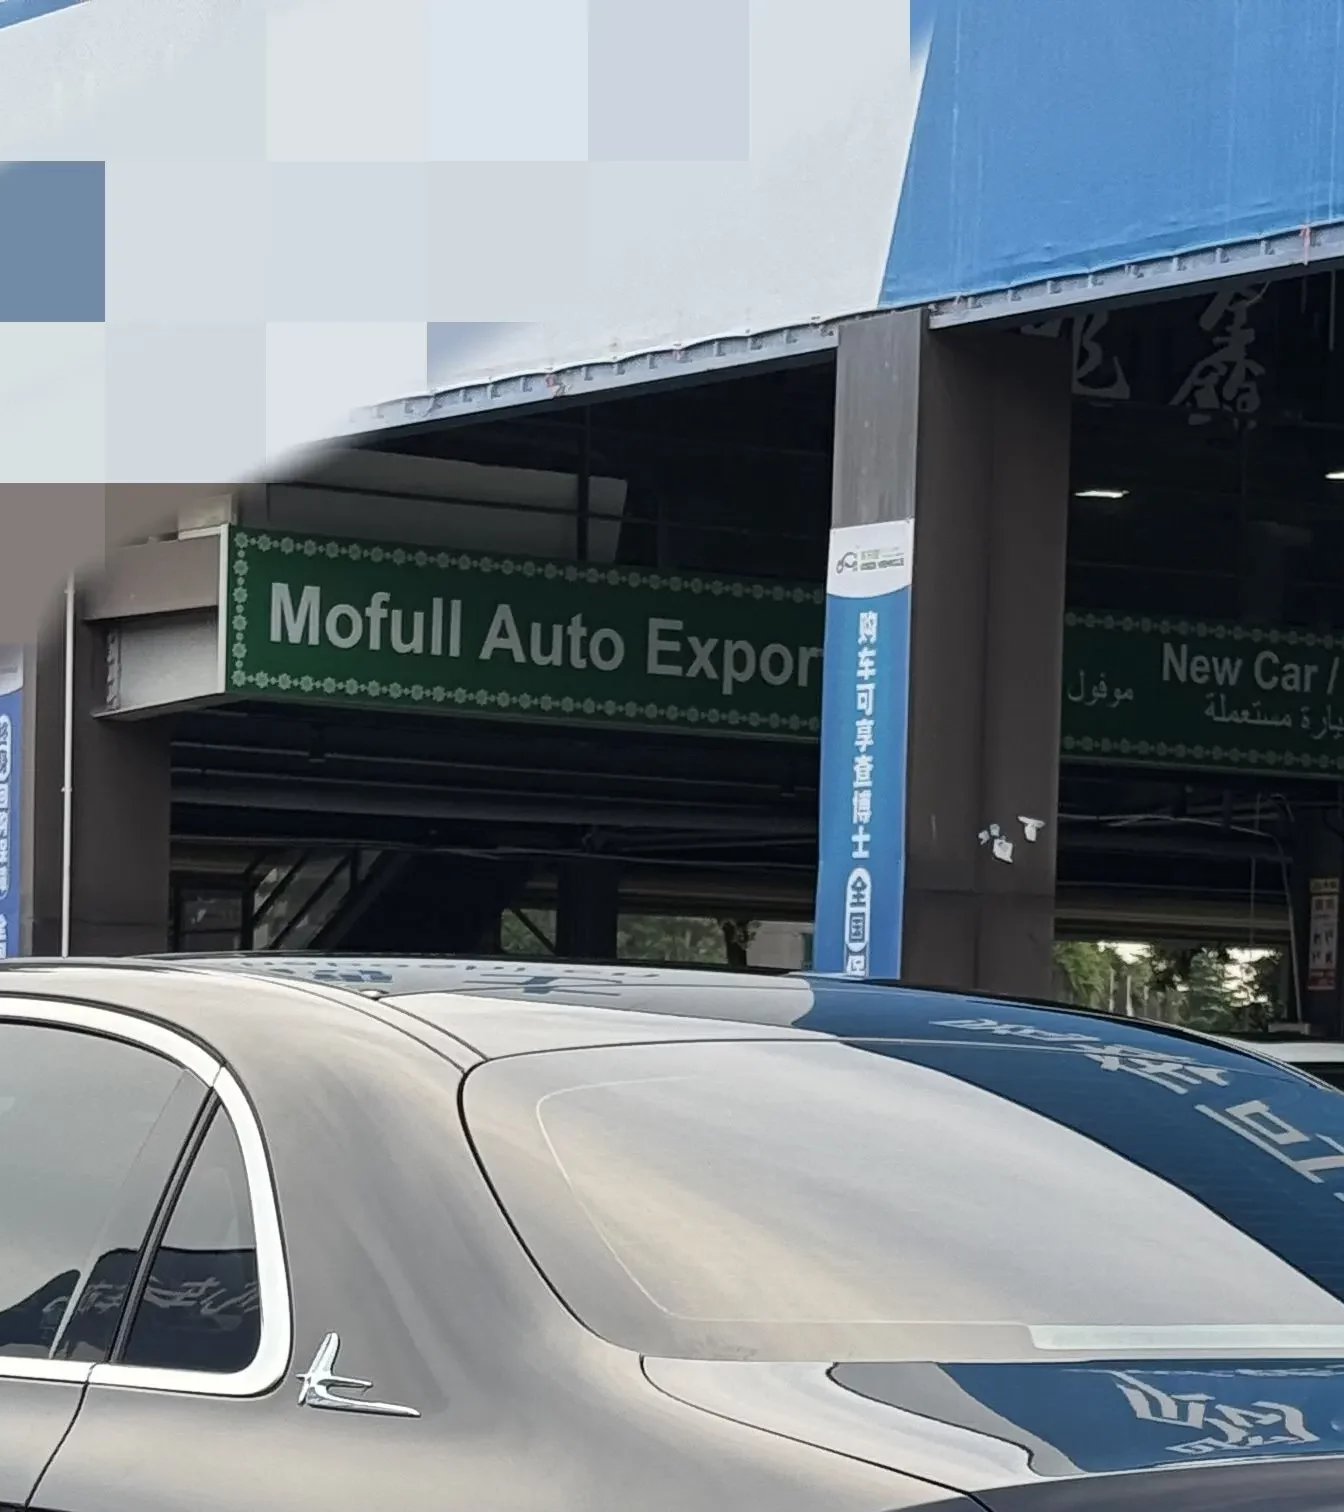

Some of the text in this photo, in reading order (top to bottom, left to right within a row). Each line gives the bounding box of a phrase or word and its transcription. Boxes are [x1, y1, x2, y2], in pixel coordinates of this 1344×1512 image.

[268, 582, 462, 658] Mofull
[478, 602, 625, 672] Auto
[1162, 642, 1244, 687] New
[1254, 650, 1319, 694] Car
[851, 610, 879, 860] 购车可享查博士
